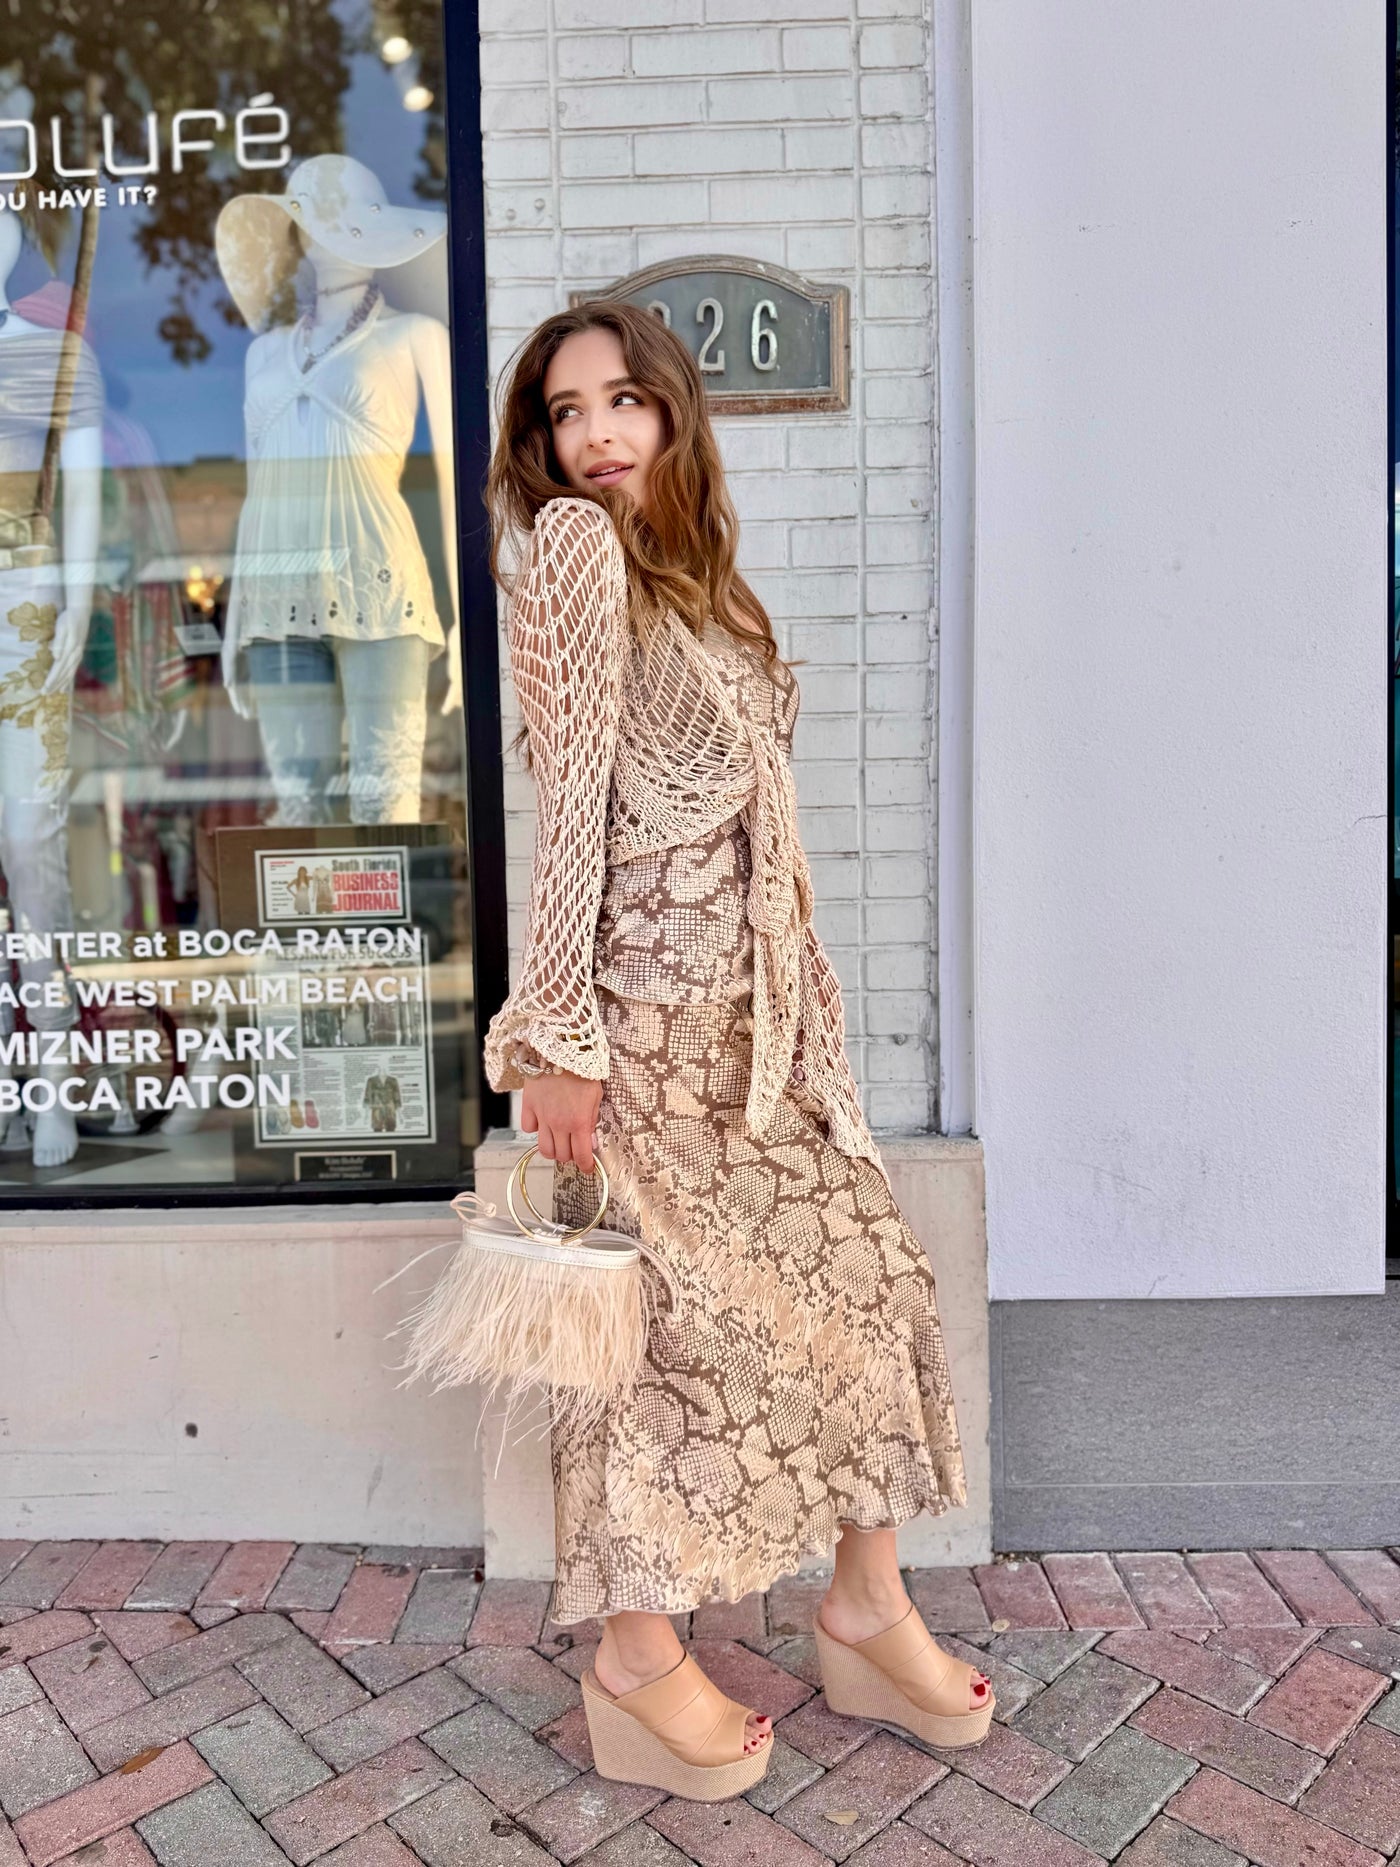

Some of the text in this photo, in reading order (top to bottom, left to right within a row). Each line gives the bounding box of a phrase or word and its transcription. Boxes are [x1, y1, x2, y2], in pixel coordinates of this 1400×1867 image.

[38, 188, 107, 210] HAVE
[118, 185, 157, 206] IT?
[332, 872, 399, 892] BUSINESS
[333, 892, 400, 912] JOURNAL
[0, 927, 421, 960] ENTER at BOCA RATON
[76, 979, 178, 1007] WEST
[191, 977, 288, 1005] PALM
[302, 976, 423, 1003] BEACH
[0, 1026, 297, 1066] MIZNER PARK
[0, 1077, 122, 1112] BOCA
[136, 1073, 291, 1110] RATON
